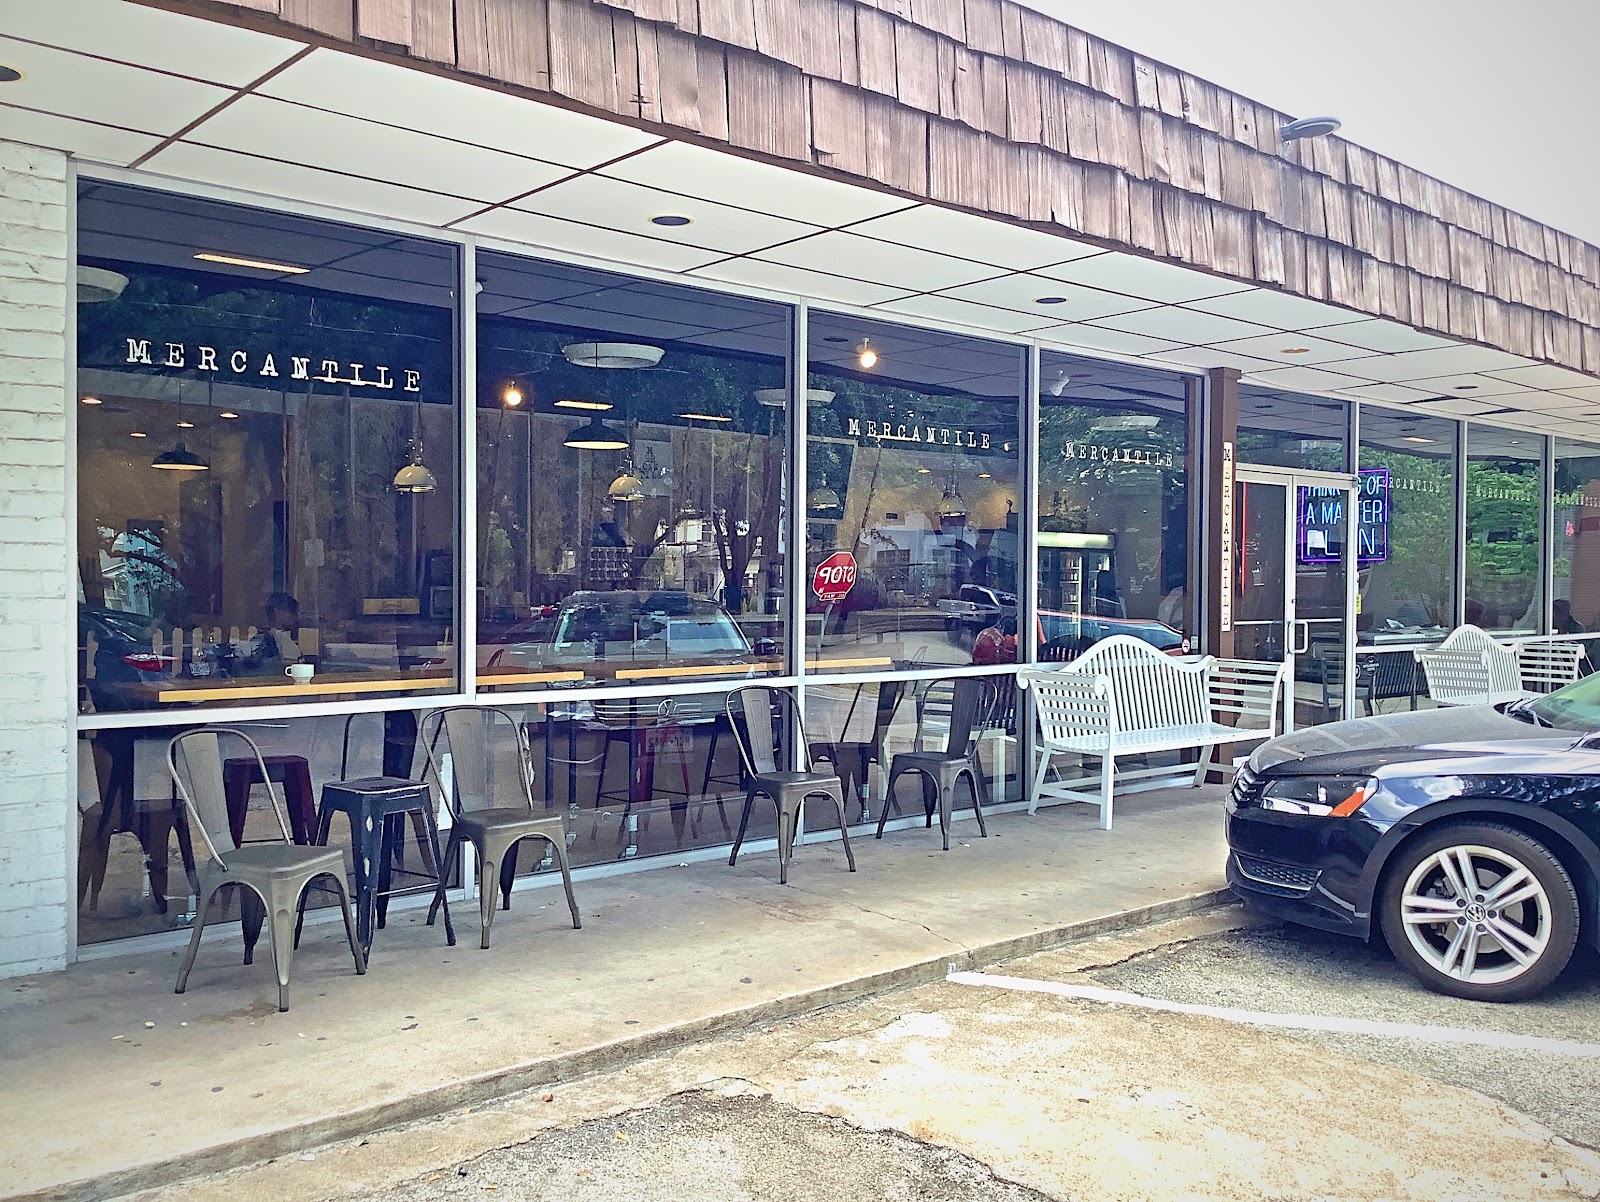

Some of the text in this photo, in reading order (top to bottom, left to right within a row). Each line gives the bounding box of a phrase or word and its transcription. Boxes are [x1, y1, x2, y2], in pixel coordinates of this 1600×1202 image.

[126, 337, 421, 392] MERCANTILE
[848, 418, 991, 449] MERCANTILE
[1065, 442, 1174, 467] MERCANTILE
[1366, 475, 1385, 495] OF
[1306, 502, 1315, 525] A
[1222, 448, 1232, 626] MERCANTILE
